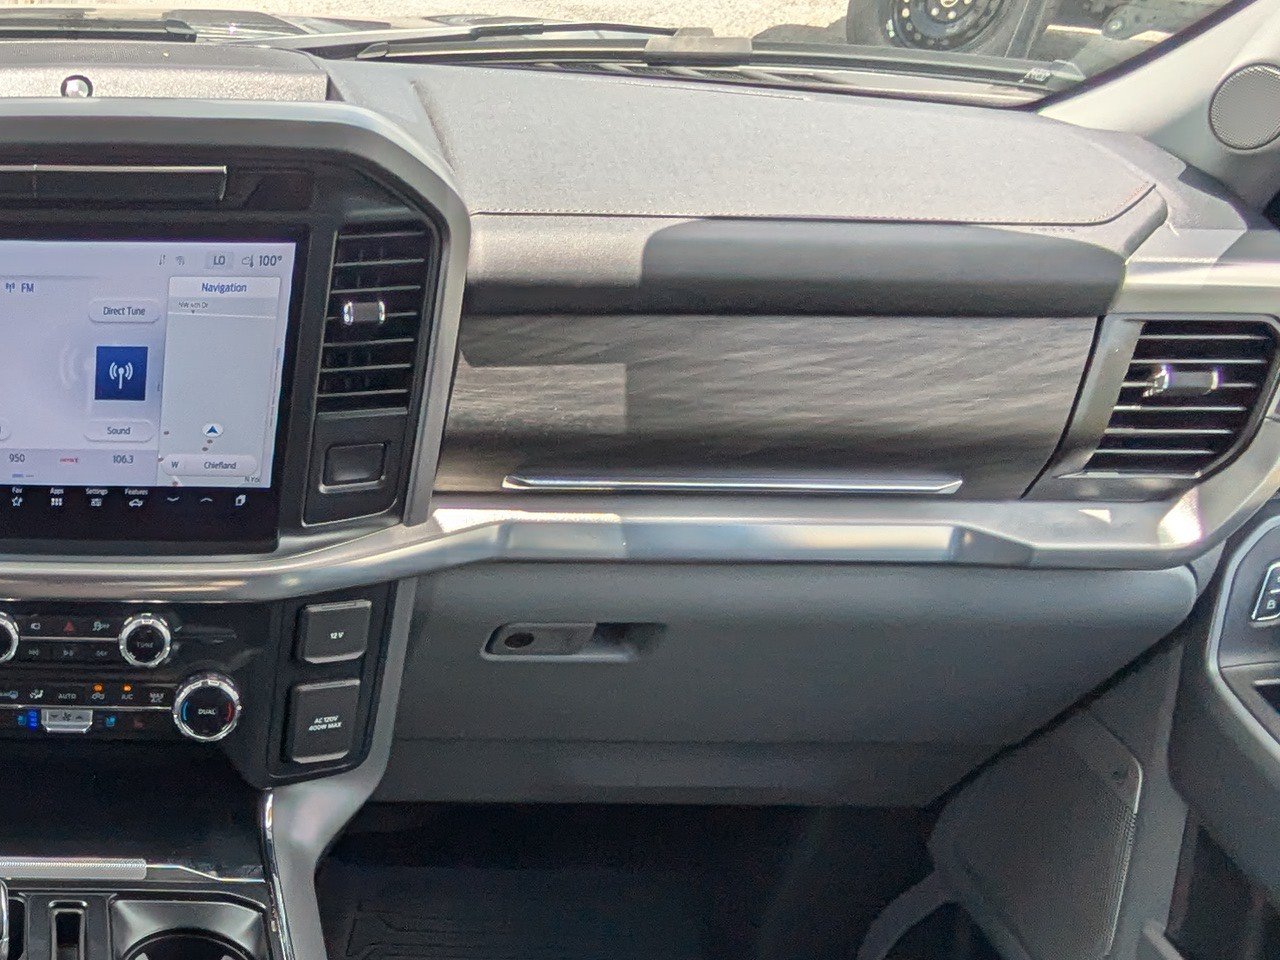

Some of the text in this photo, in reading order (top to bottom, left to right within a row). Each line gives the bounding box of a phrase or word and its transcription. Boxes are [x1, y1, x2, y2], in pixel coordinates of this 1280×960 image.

[213, 255, 226, 265] LO
[21, 283, 34, 292] FM
[201, 282, 247, 294] Navigation
[103, 306, 146, 316] Direct Tune
[107, 426, 131, 436] Sound
[9, 453, 25, 463] 950
[113, 454, 134, 464] 106.3
[171, 461, 179, 469] W
[203, 461, 236, 470] Chiefland
[197, 708, 216, 716] DUAL
